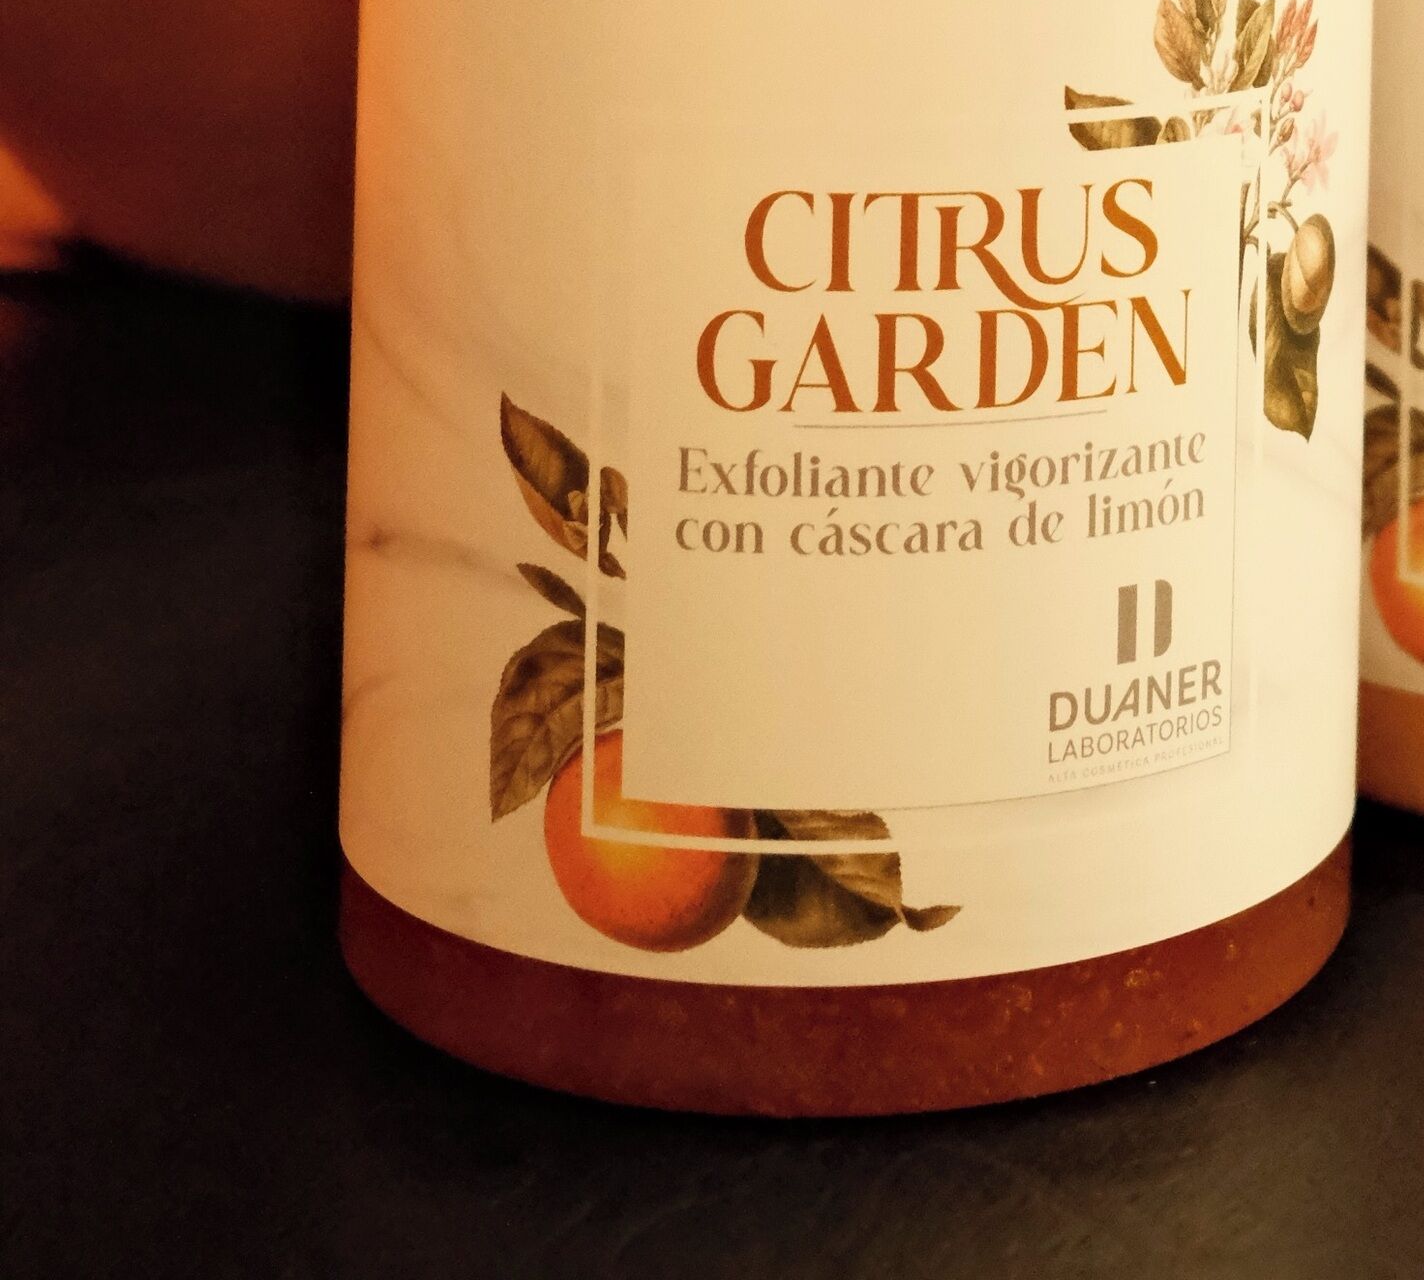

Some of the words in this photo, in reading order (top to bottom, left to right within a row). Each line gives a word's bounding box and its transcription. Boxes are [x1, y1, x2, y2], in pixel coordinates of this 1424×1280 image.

[744, 178, 1159, 311] CITRUS
[696, 289, 1192, 413] GARDEN
[677, 446, 935, 498] Exfoliante
[960, 431, 1207, 500] vigorizante
[675, 516, 764, 554] con
[790, 507, 984, 556] cáscara
[1008, 501, 1064, 547] de
[1086, 478, 1206, 539] limón
[1049, 659, 1222, 732] DUANER
[1047, 705, 1222, 764] LABORATORIOS
